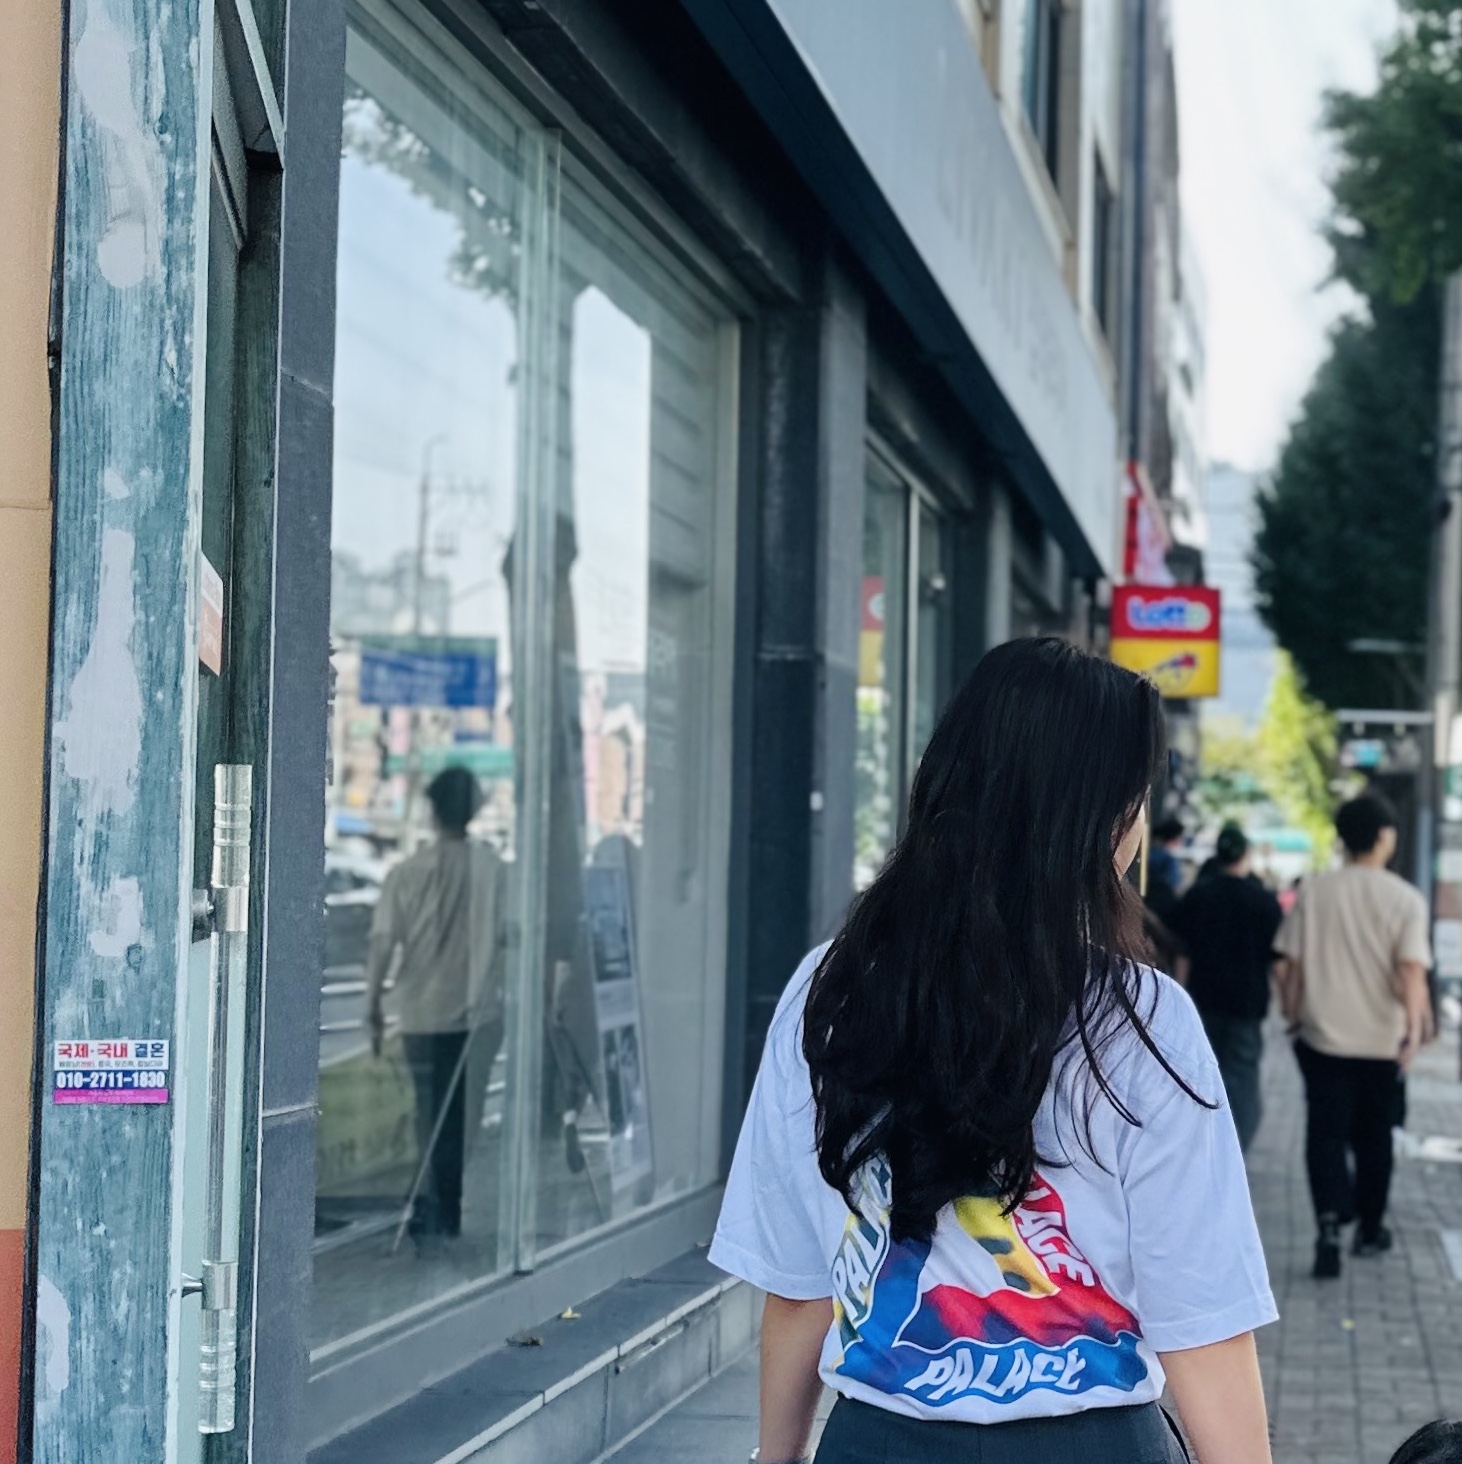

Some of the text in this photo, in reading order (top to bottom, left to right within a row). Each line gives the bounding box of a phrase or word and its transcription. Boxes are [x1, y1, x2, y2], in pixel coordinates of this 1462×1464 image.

[135, 1043, 165, 1058] 결혼
[56, 1071, 165, 1089] 010-2711-1830
[904, 1348, 1087, 1400] PALACE
